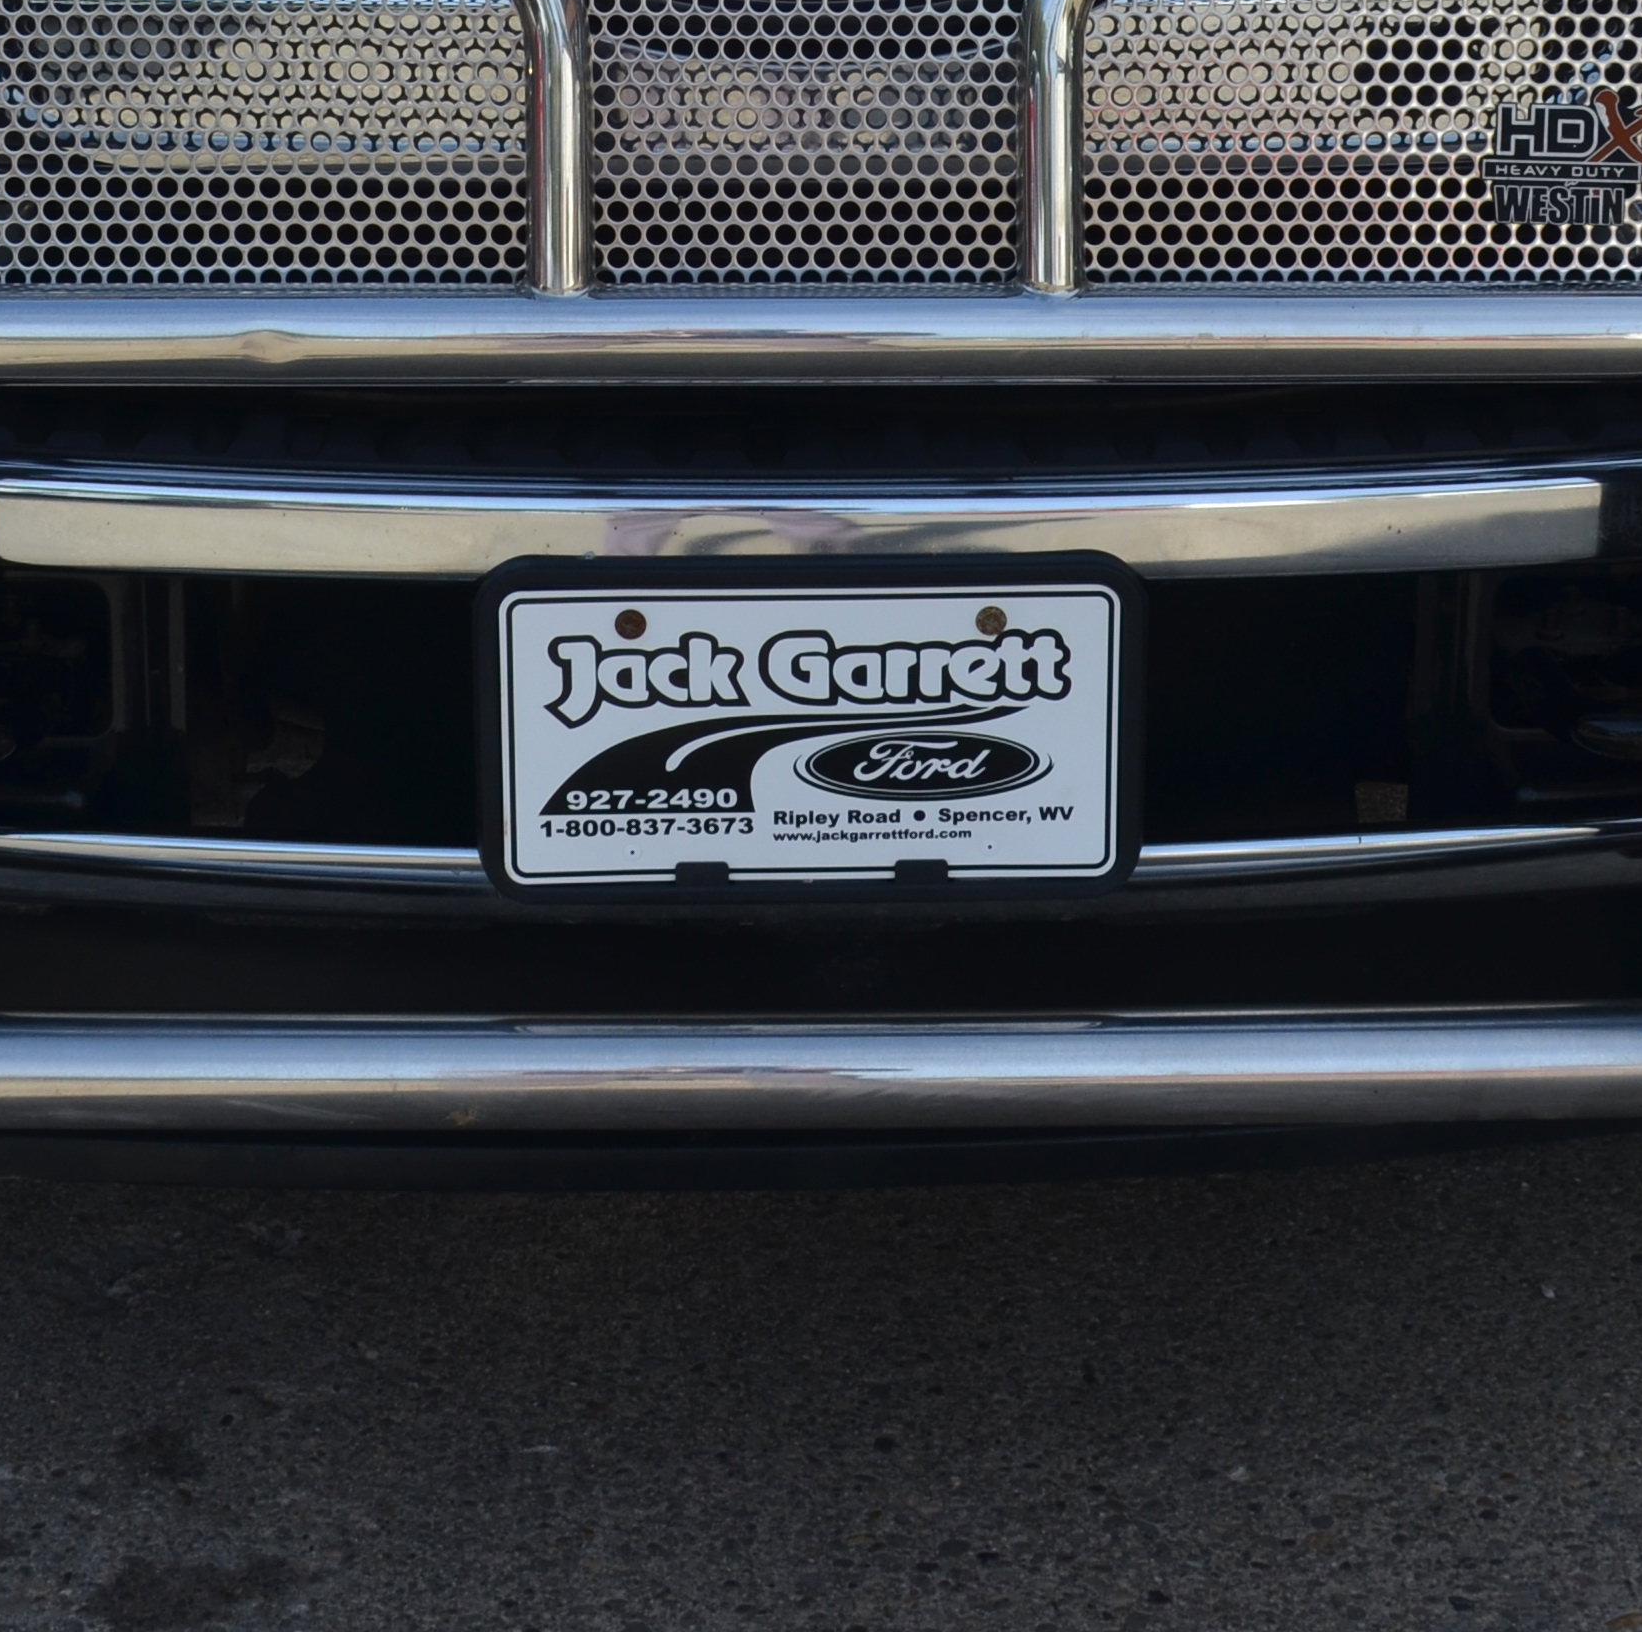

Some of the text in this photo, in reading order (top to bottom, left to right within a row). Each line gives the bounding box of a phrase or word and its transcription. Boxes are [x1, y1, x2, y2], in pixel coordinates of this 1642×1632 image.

[1494, 164, 1625, 178] HEAVY DUTY
[543, 629, 1072, 729] Jack Garrett
[853, 740, 991, 782] Ford
[566, 788, 739, 812] 927-2490
[539, 817, 755, 838] 1-800-837-3673
[772, 805, 1075, 829] Ripley Road Spencer, WV
[772, 828, 973, 843] www.jackgarrettford.com
